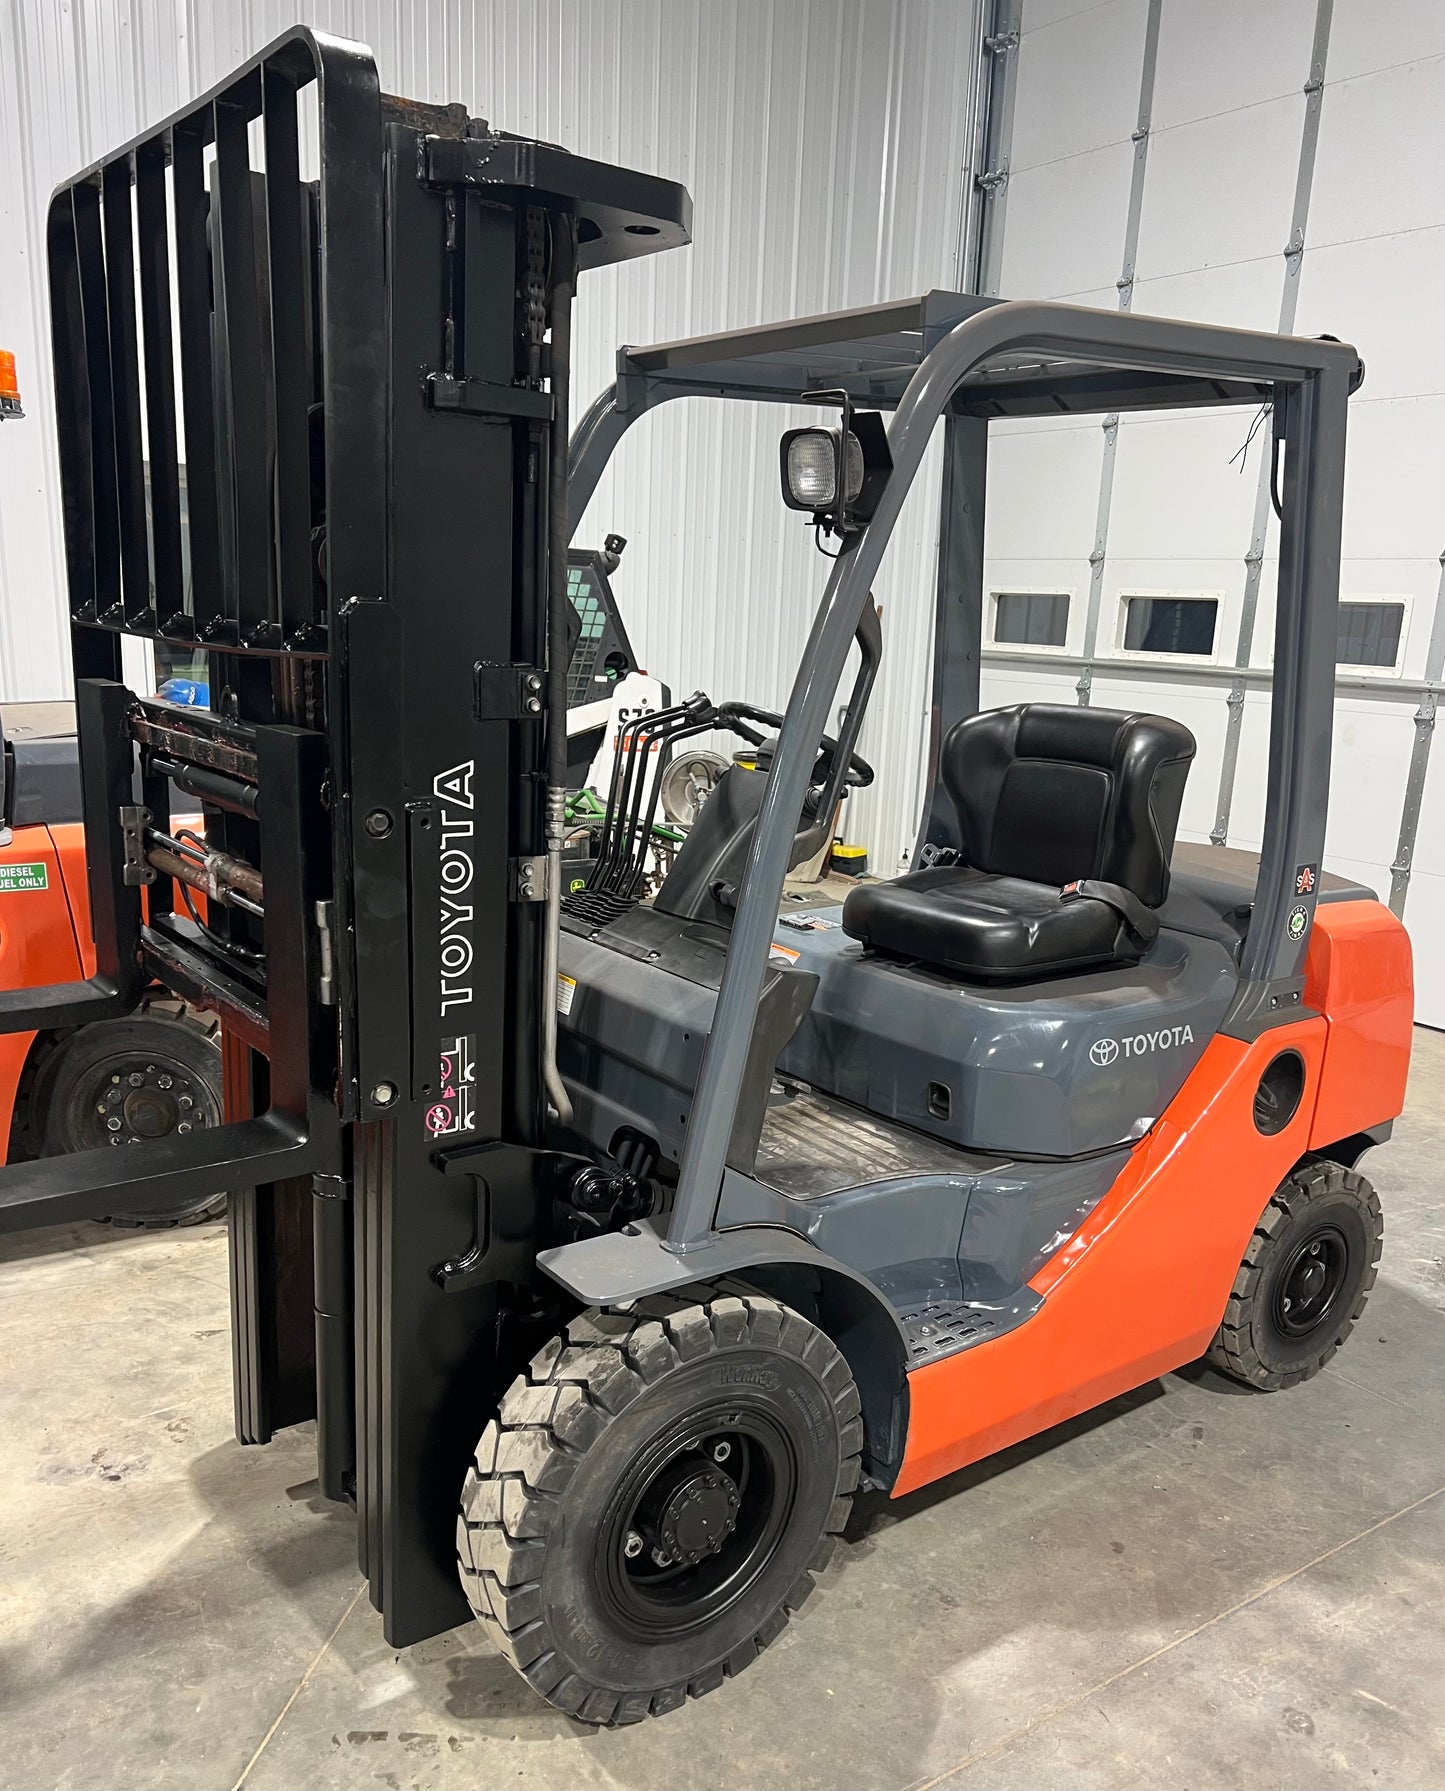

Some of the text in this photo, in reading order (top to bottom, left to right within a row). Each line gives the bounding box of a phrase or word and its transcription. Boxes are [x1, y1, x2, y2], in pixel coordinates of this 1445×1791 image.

[1, 866, 34, 877] DIESEL
[18, 877, 44, 887] ONLY
[433, 760, 475, 1016] TOYOTA
[1121, 1024, 1194, 1057] TOYOTA
